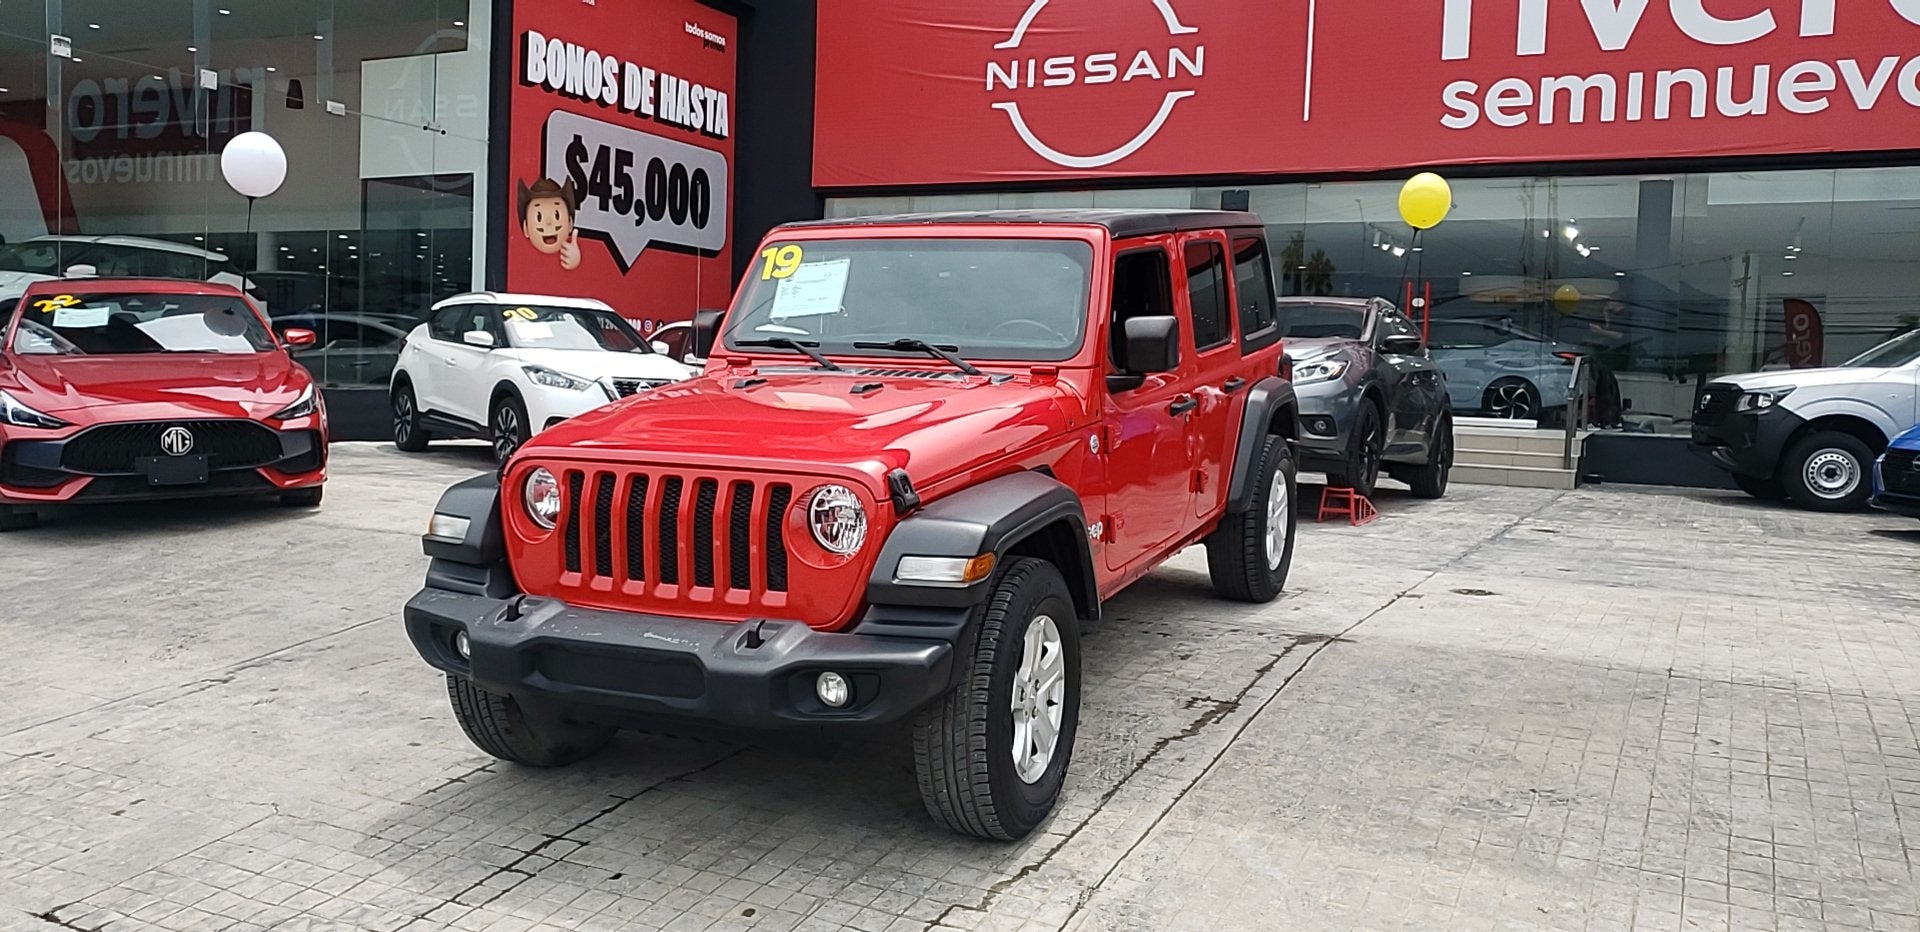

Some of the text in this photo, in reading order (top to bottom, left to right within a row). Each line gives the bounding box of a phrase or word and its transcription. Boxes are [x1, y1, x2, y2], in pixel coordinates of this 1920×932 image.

[685, 21, 704, 38] todos
[527, 30, 729, 137] BONOS DE HASTA
[986, 46, 1205, 91] NISSAN
[565, 134, 711, 230] $45,000
[761, 244, 803, 281] 19
[33, 295, 82, 312] 22
[503, 307, 538, 321] 20
[164, 430, 191, 453] MG
